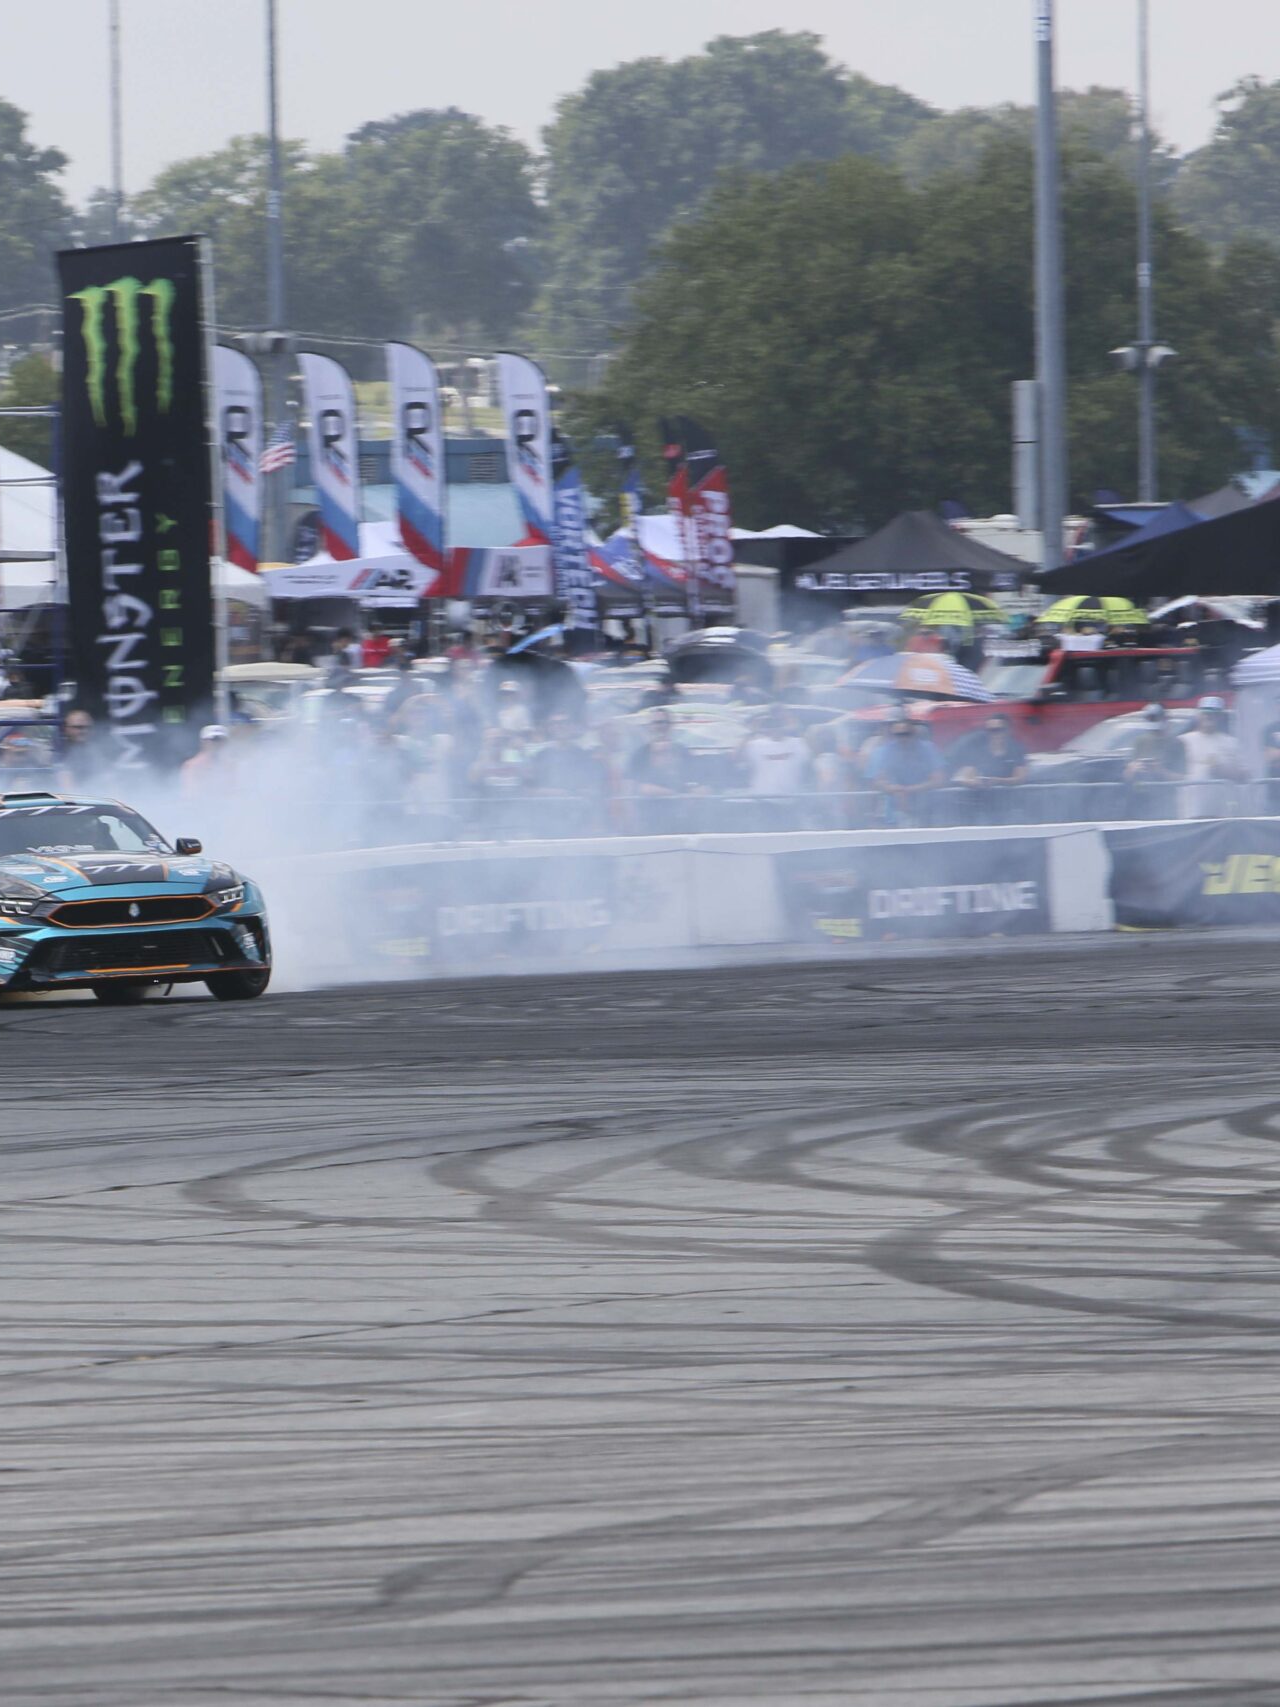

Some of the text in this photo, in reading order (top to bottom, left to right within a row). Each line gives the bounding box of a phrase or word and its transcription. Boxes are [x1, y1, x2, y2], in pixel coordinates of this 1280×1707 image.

[95, 460, 158, 770] MONSTER
[155, 512, 186, 723] ENERGY
[869, 881, 1038, 918] DRIFTING
[1199, 854, 1280, 895] JE
